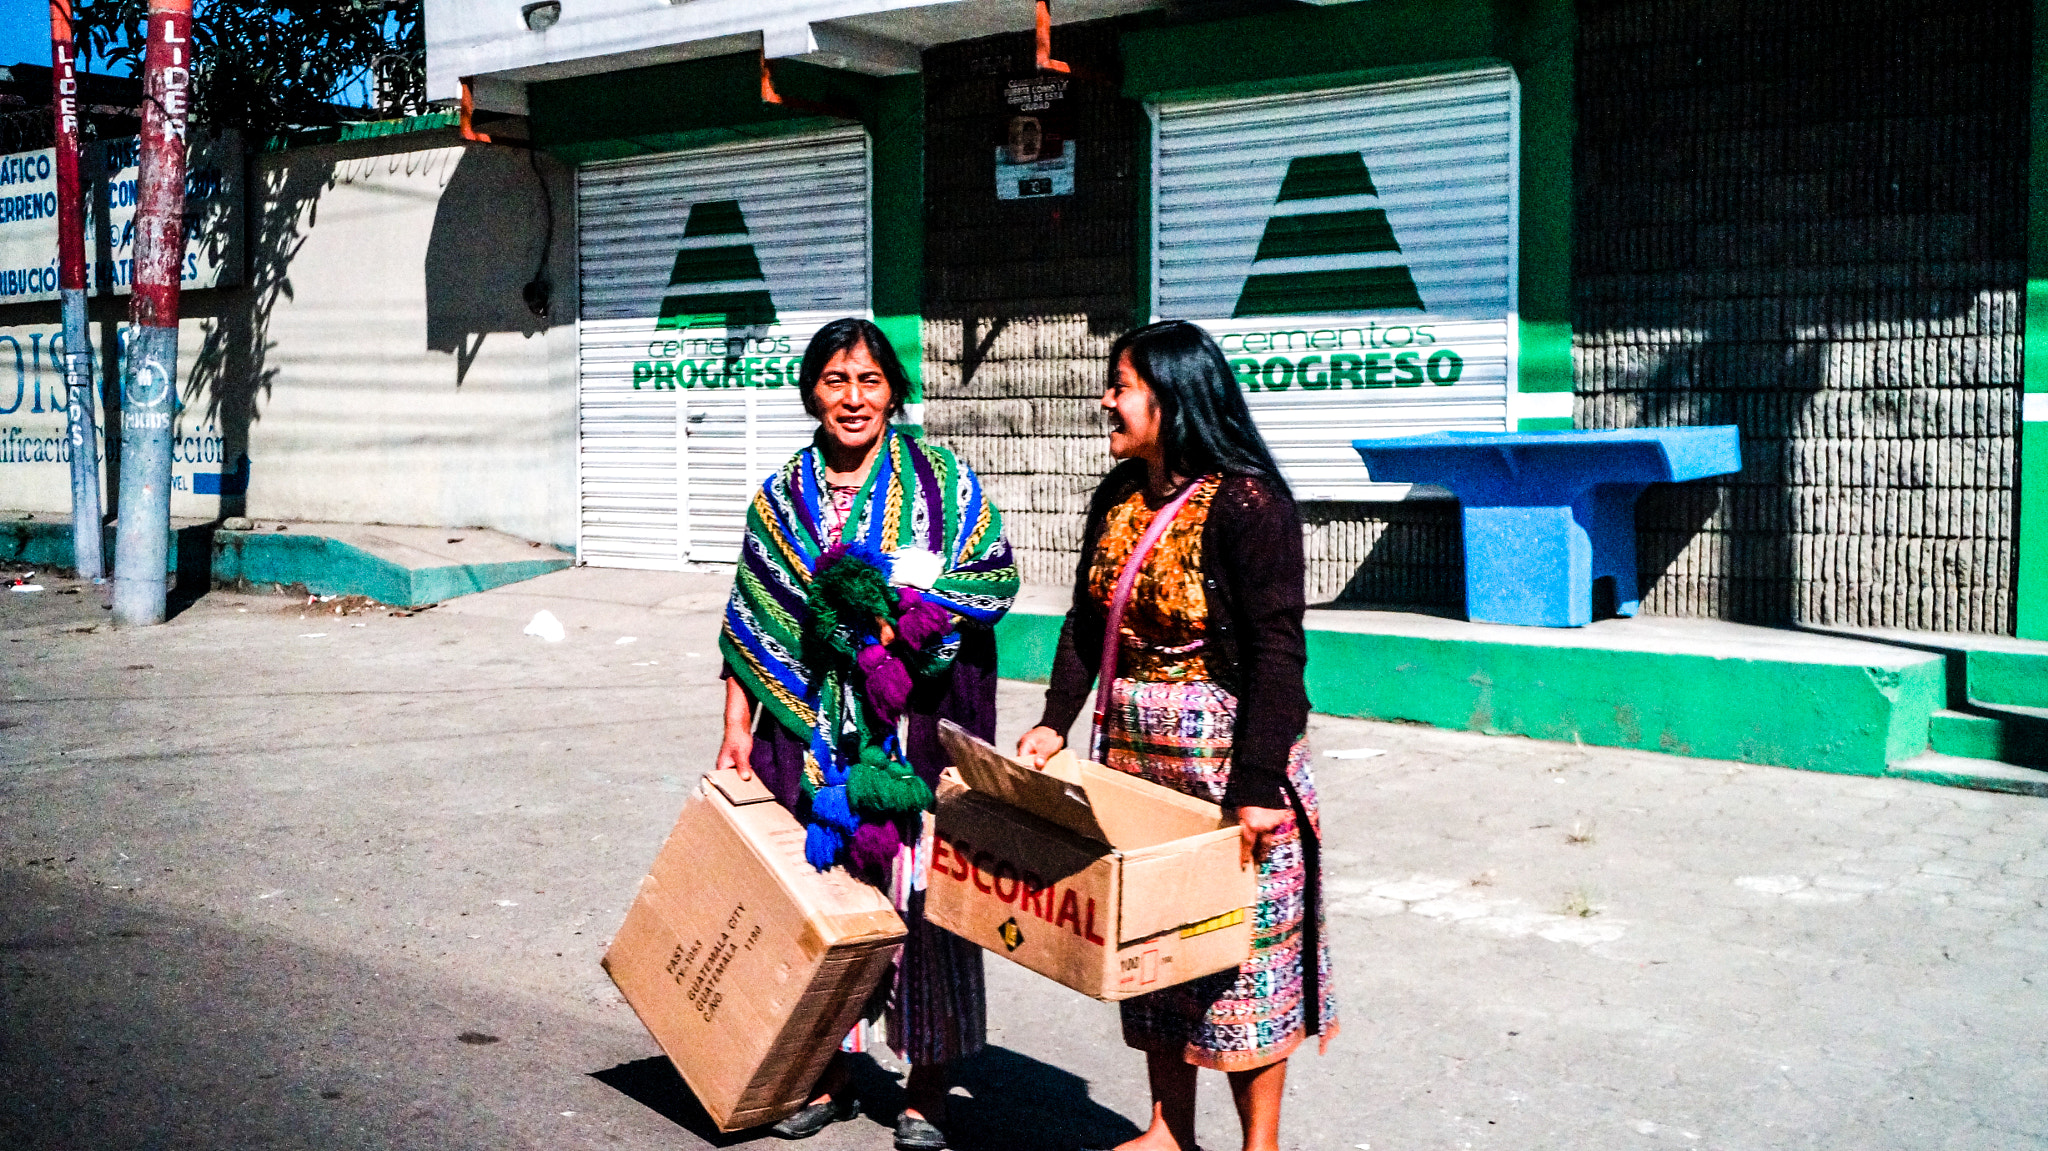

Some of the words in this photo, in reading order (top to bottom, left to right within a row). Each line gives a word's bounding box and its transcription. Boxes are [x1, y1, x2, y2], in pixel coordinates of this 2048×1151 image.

[57, 45, 78, 134] LIDER
[163, 20, 189, 146] LIDER
[1033, 93, 1044, 102] DE
[648, 335, 791, 359] cementos
[1220, 321, 1436, 354] cementos
[1228, 349, 1463, 392] ROGRESO
[931, 832, 1105, 947] ESCORIAL
[687, 932, 730, 1001] GUATEMALA
[728, 902, 746, 929] CITY
[696, 943, 738, 1012] GUATEMALA
